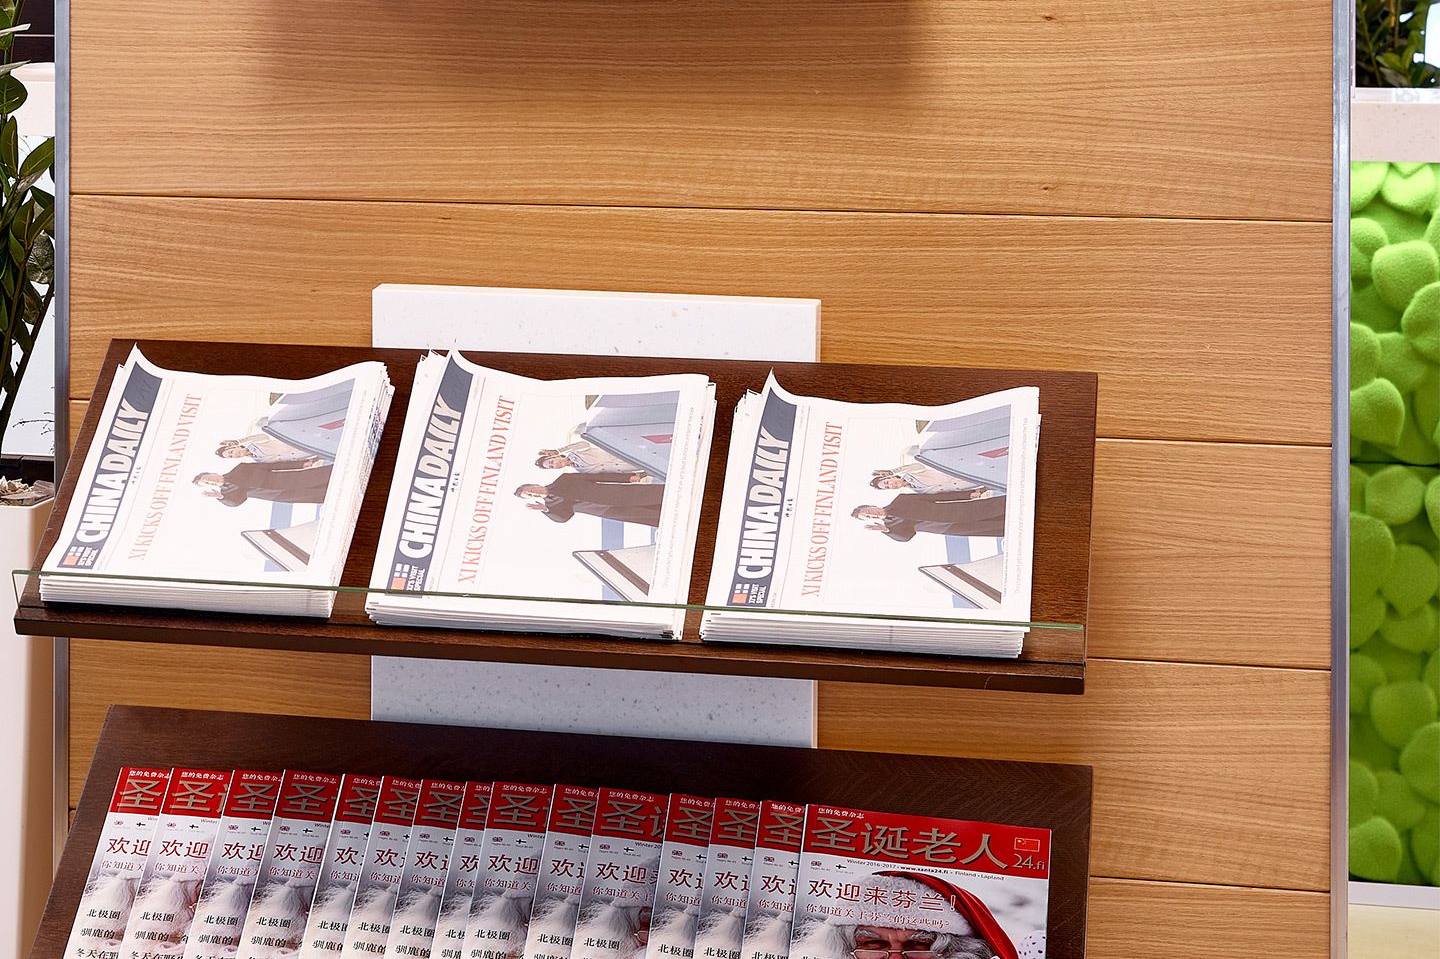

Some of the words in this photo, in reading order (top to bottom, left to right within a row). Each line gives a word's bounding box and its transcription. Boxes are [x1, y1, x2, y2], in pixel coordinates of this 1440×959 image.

[492, 395, 515, 433] VISIT
[822, 421, 843, 458] VISIT
[479, 434, 508, 495] FINLAND
[814, 458, 839, 519] FINLAND
[473, 498, 496, 525] OFF
[461, 526, 487, 569] KICKS
[810, 519, 831, 546] OFF
[458, 570, 476, 584] XI
[804, 547, 827, 583] KICKS
[801, 583, 821, 597] XI
[117, 778, 162, 810] 圣
[231, 782, 277, 814] 圣
[421, 790, 463, 823] 圣
[556, 796, 597, 830] 圣
[673, 807, 713, 841] 圣
[718, 808, 758, 842] 圣
[764, 812, 804, 846] 圣
[159, 839, 209, 859] 欢迎
[273, 843, 324, 864] 欢迎
[811, 816, 1008, 869] 圣诞老人
[487, 854, 539, 875] 欢迎
[900, 865, 949, 875] www.santa24.fi
[954, 870, 977, 878] Finland
[981, 874, 1005, 882] Lapland
[1012, 853, 1045, 871] 24.fi
